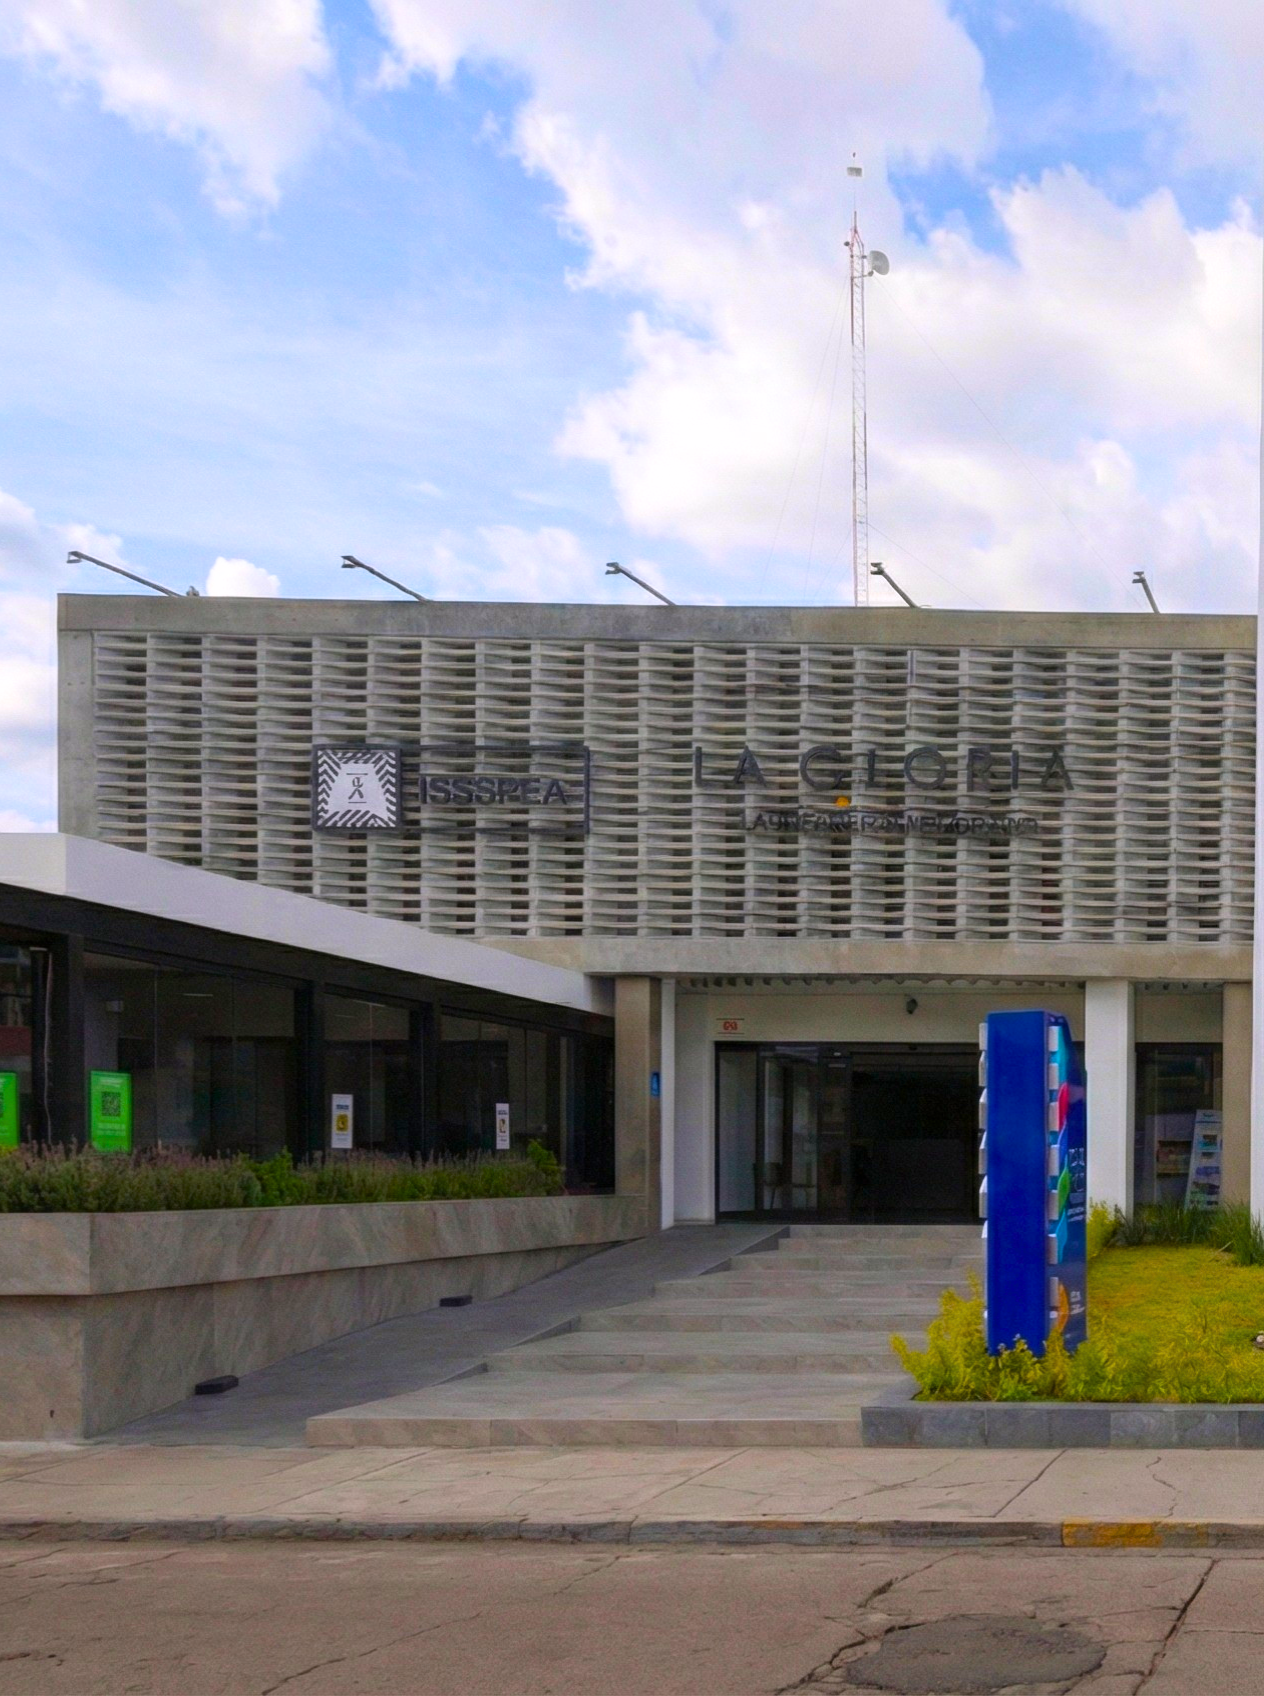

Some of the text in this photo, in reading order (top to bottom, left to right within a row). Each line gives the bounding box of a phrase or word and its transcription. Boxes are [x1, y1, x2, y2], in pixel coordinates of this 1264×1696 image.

[694, 744, 1075, 792] LA GLORIA
[418, 775, 567, 805] ISSSPEA
